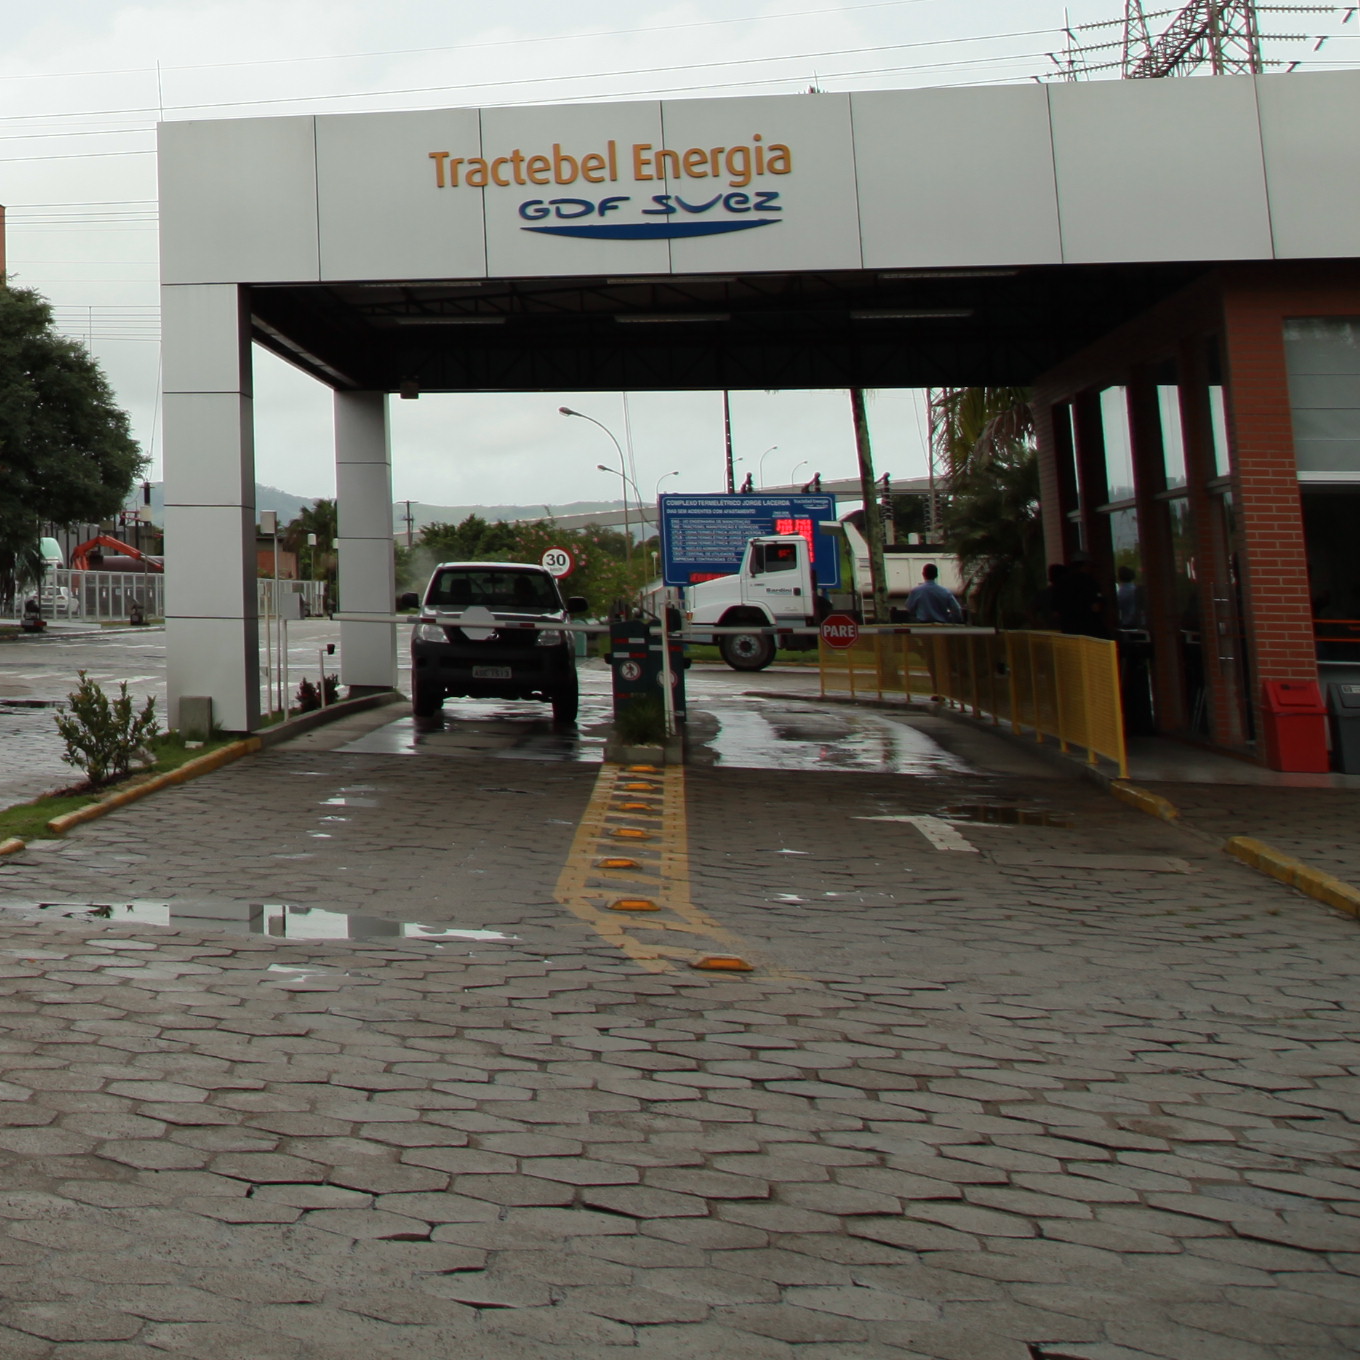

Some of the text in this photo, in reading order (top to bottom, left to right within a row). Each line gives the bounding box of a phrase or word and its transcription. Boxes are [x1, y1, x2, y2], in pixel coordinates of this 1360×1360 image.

[428, 133, 793, 188] Tractebel Energia
[518, 196, 631, 220] GDF
[546, 554, 567, 567] 30
[823, 625, 855, 638] PARE
